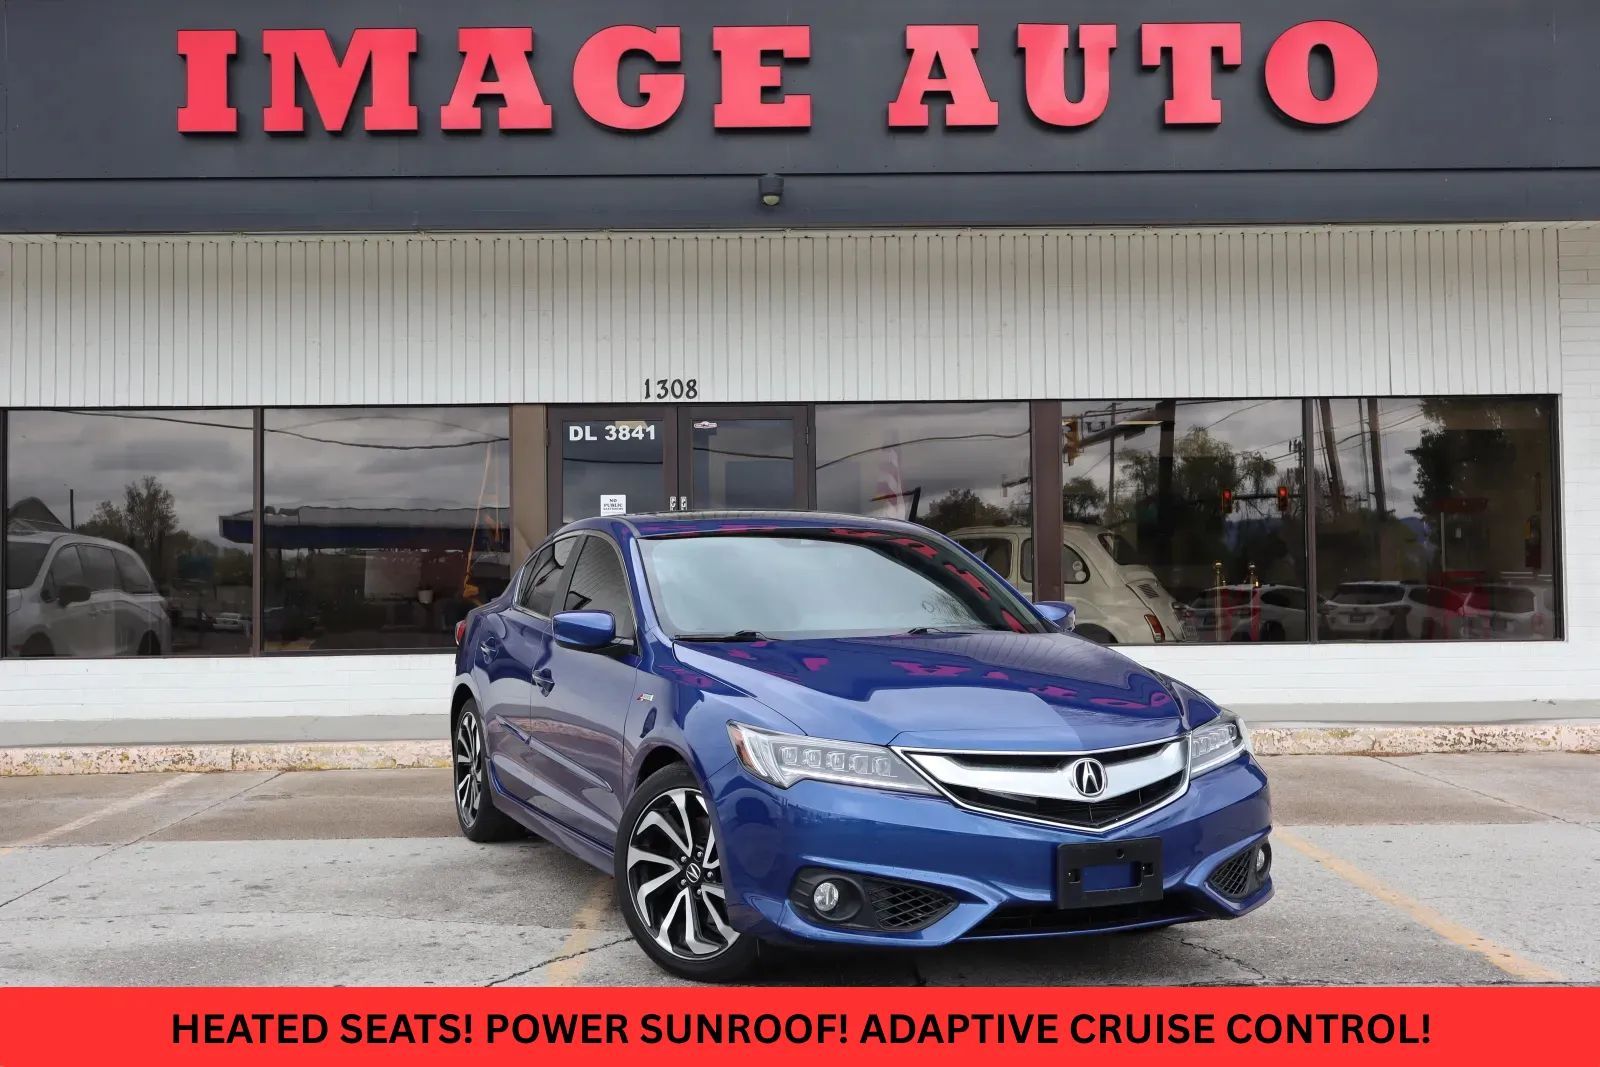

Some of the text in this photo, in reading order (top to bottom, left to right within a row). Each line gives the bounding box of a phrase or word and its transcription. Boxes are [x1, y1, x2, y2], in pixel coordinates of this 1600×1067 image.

[177, 20, 1379, 133] IMAGE AUTO
[644, 378, 698, 399] 1308
[569, 424, 656, 441] DL 3841
